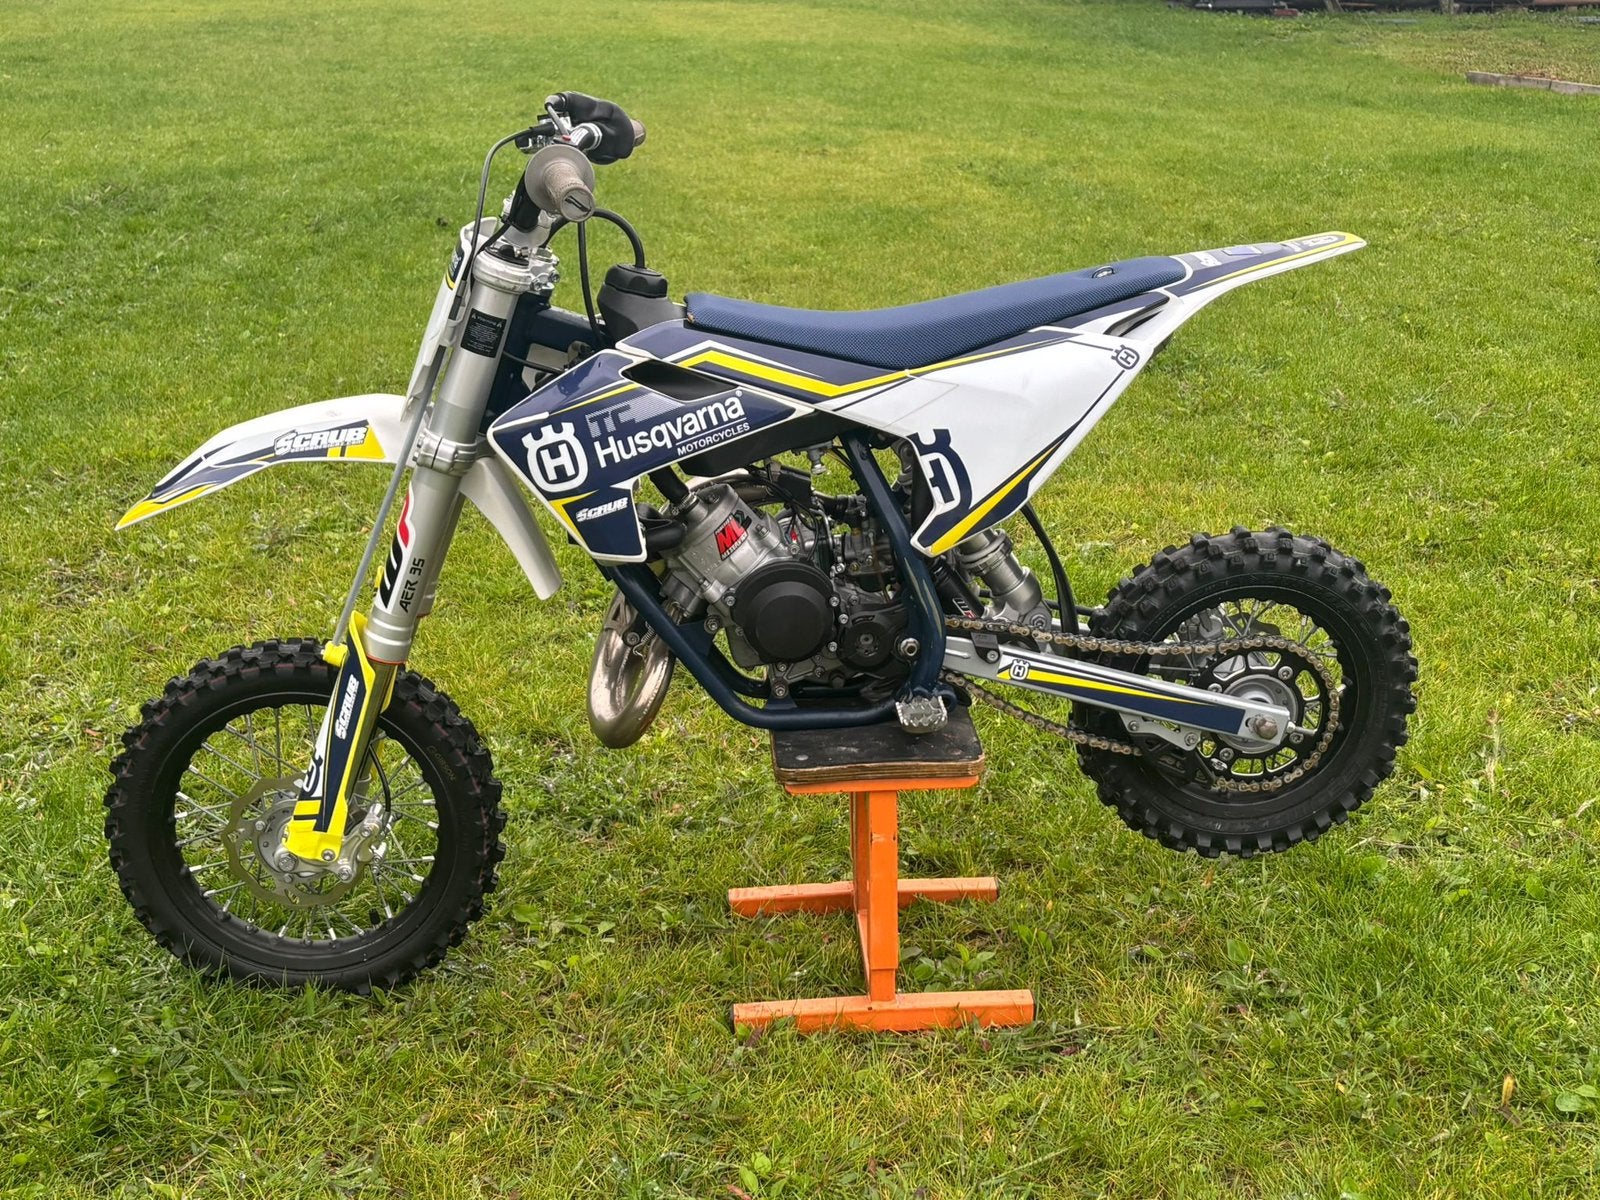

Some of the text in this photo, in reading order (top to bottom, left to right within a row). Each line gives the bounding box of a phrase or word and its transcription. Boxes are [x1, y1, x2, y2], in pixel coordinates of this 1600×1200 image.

[594, 396, 745, 469] Husqvarna
[677, 422, 750, 456] MOTORCYCLES
[399, 557, 425, 613] AER 35
